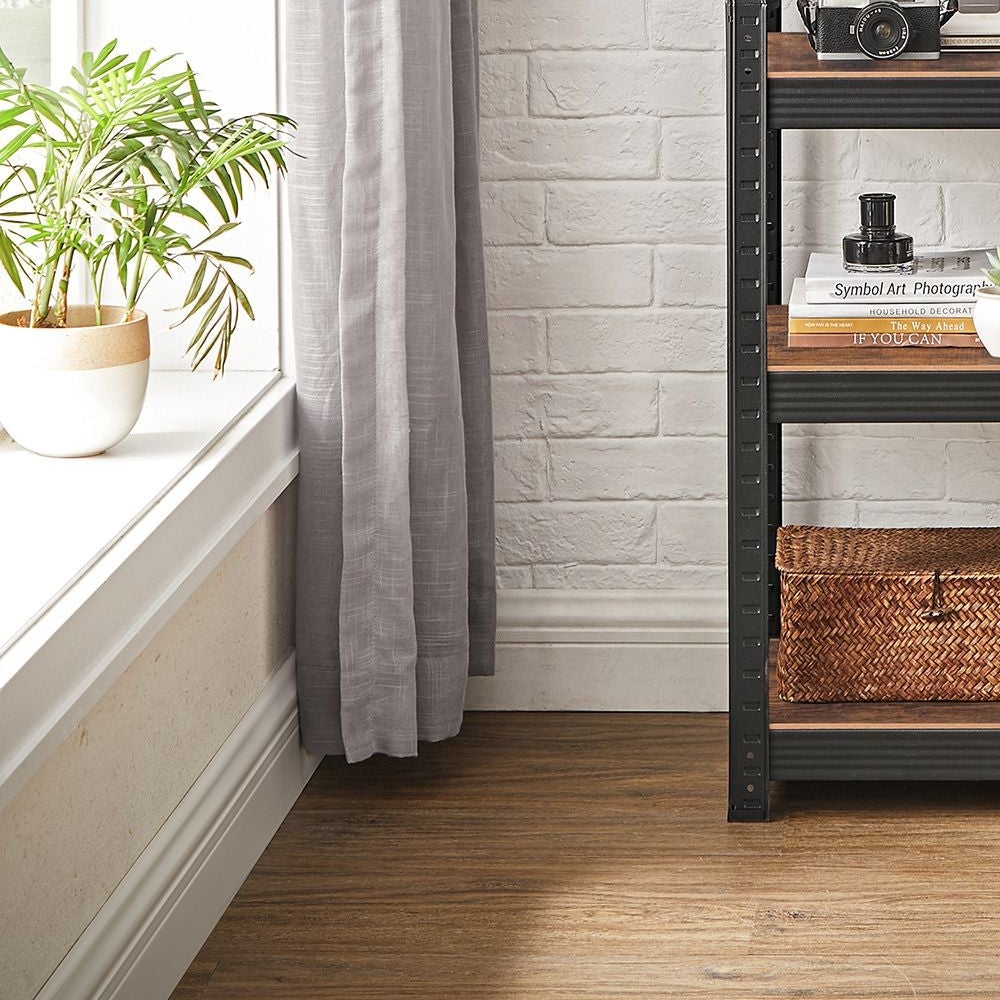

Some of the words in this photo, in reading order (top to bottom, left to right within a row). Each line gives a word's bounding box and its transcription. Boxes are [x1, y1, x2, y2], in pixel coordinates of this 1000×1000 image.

[834, 281, 884, 300] Symbol
[886, 282, 907, 296] Art
[913, 280, 992, 298] Photograp
[869, 308, 927, 316] HOUSEHOLD
[929, 307, 973, 315] DECORAT
[890, 321, 908, 330] The
[911, 321, 932, 333] Way
[935, 321, 965, 331] Ahead
[853, 333, 867, 345] IF
[870, 333, 905, 345] YOU
[908, 333, 943, 345] CAN
